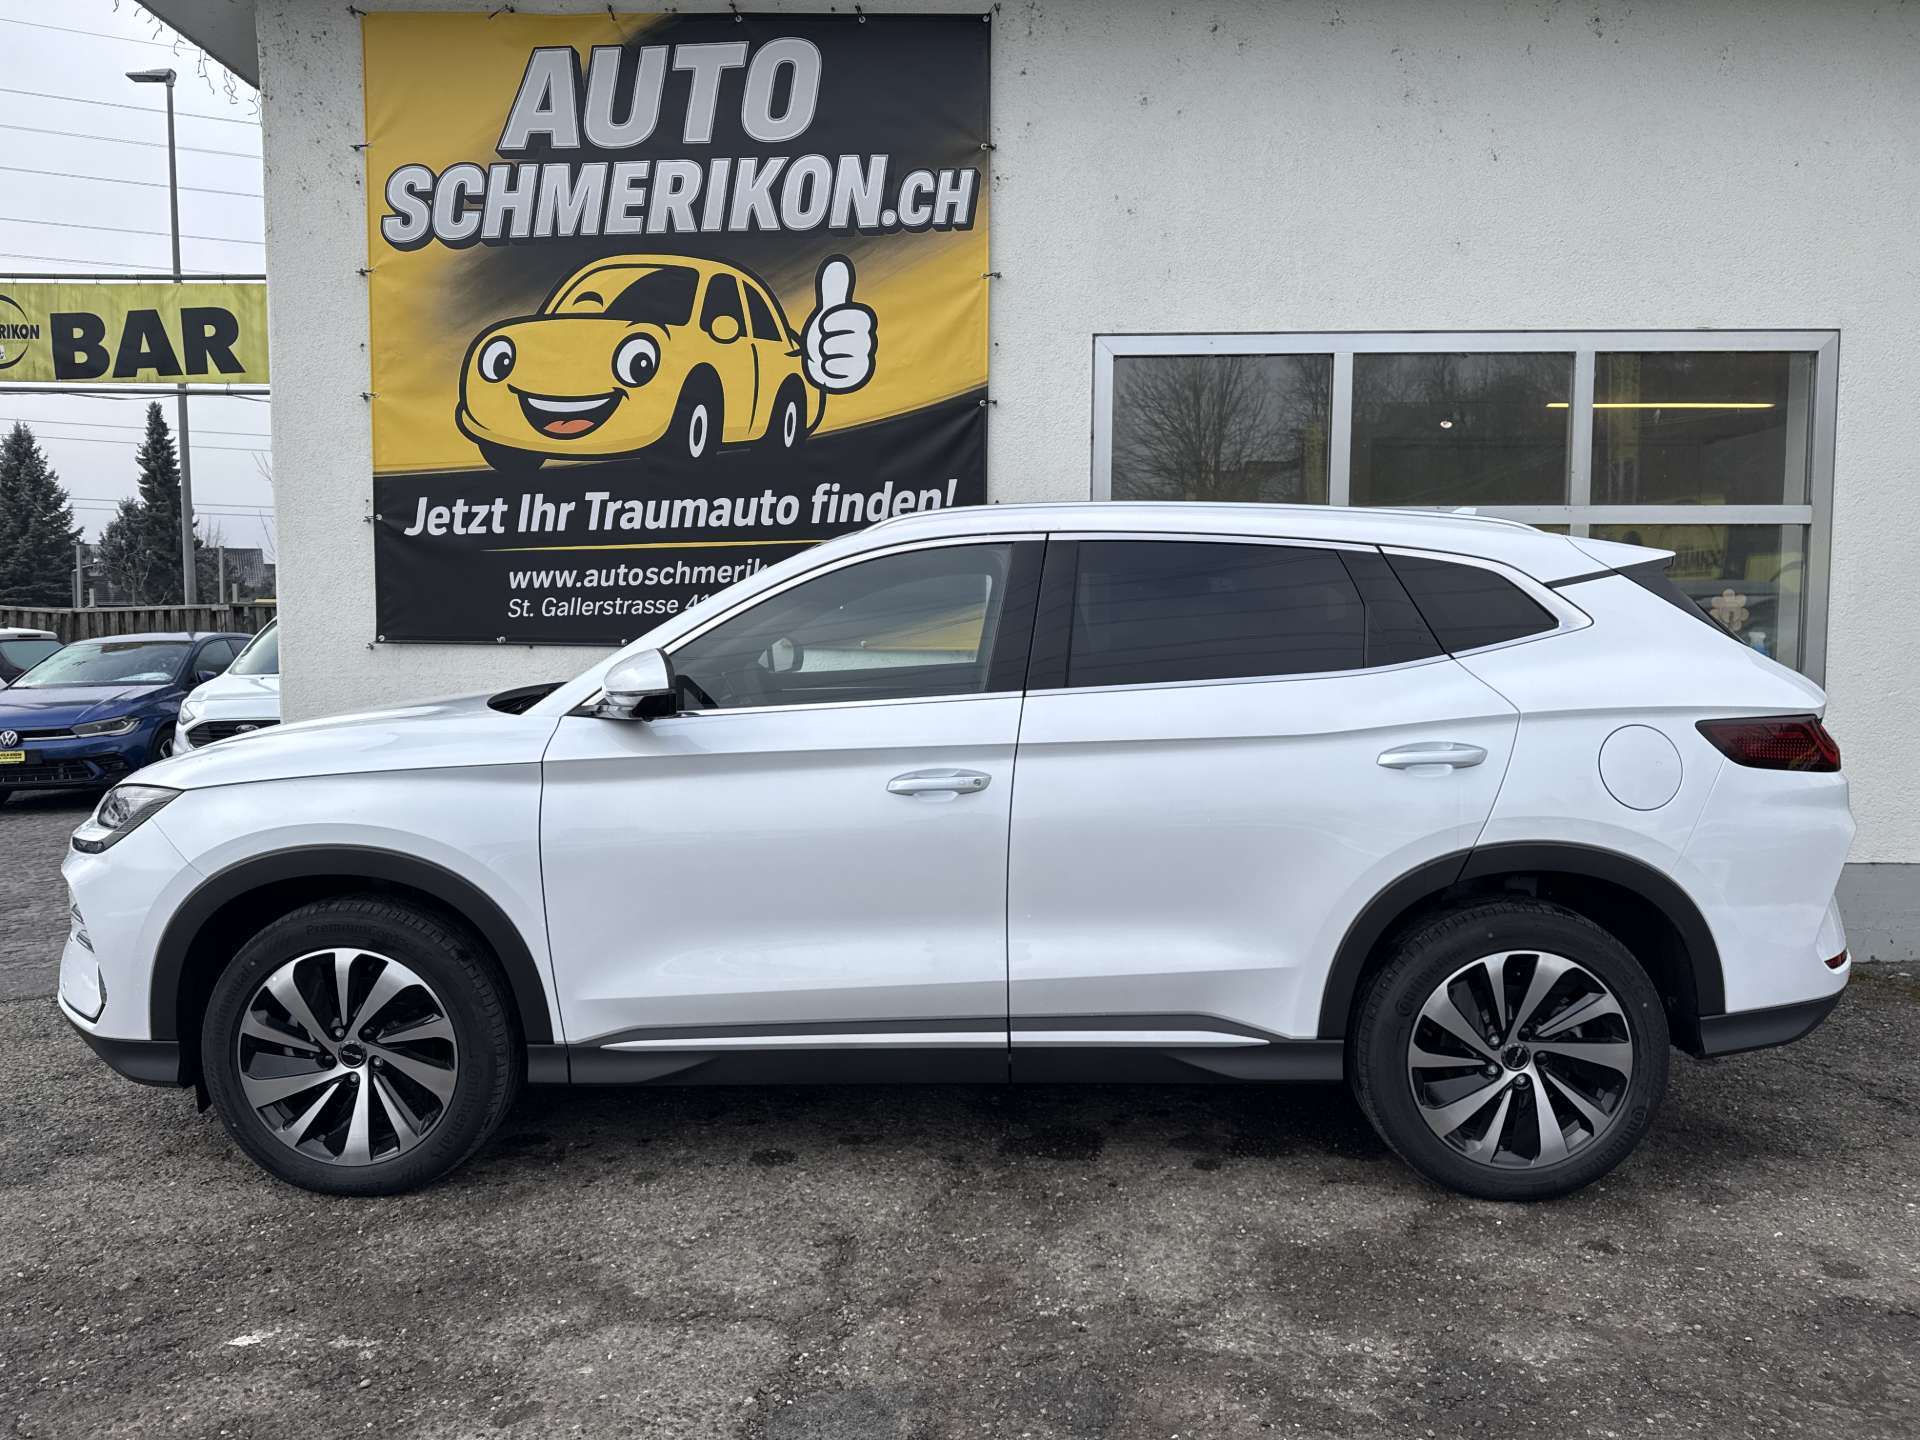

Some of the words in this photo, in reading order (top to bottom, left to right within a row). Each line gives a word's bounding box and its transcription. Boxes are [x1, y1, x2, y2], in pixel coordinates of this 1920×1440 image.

[498, 36, 822, 152] AUTO
[380, 153, 976, 243] SCHMERIKON.CH
[50, 306, 246, 380] BAR
[404, 497, 508, 537] Jetzt
[517, 493, 575, 533] Ihr
[585, 491, 799, 530] Traumauto
[811, 478, 958, 524] finden!
[507, 598, 535, 618] St.
[541, 595, 679, 618] Gallerstrasse
[685, 594, 711, 610] 4
